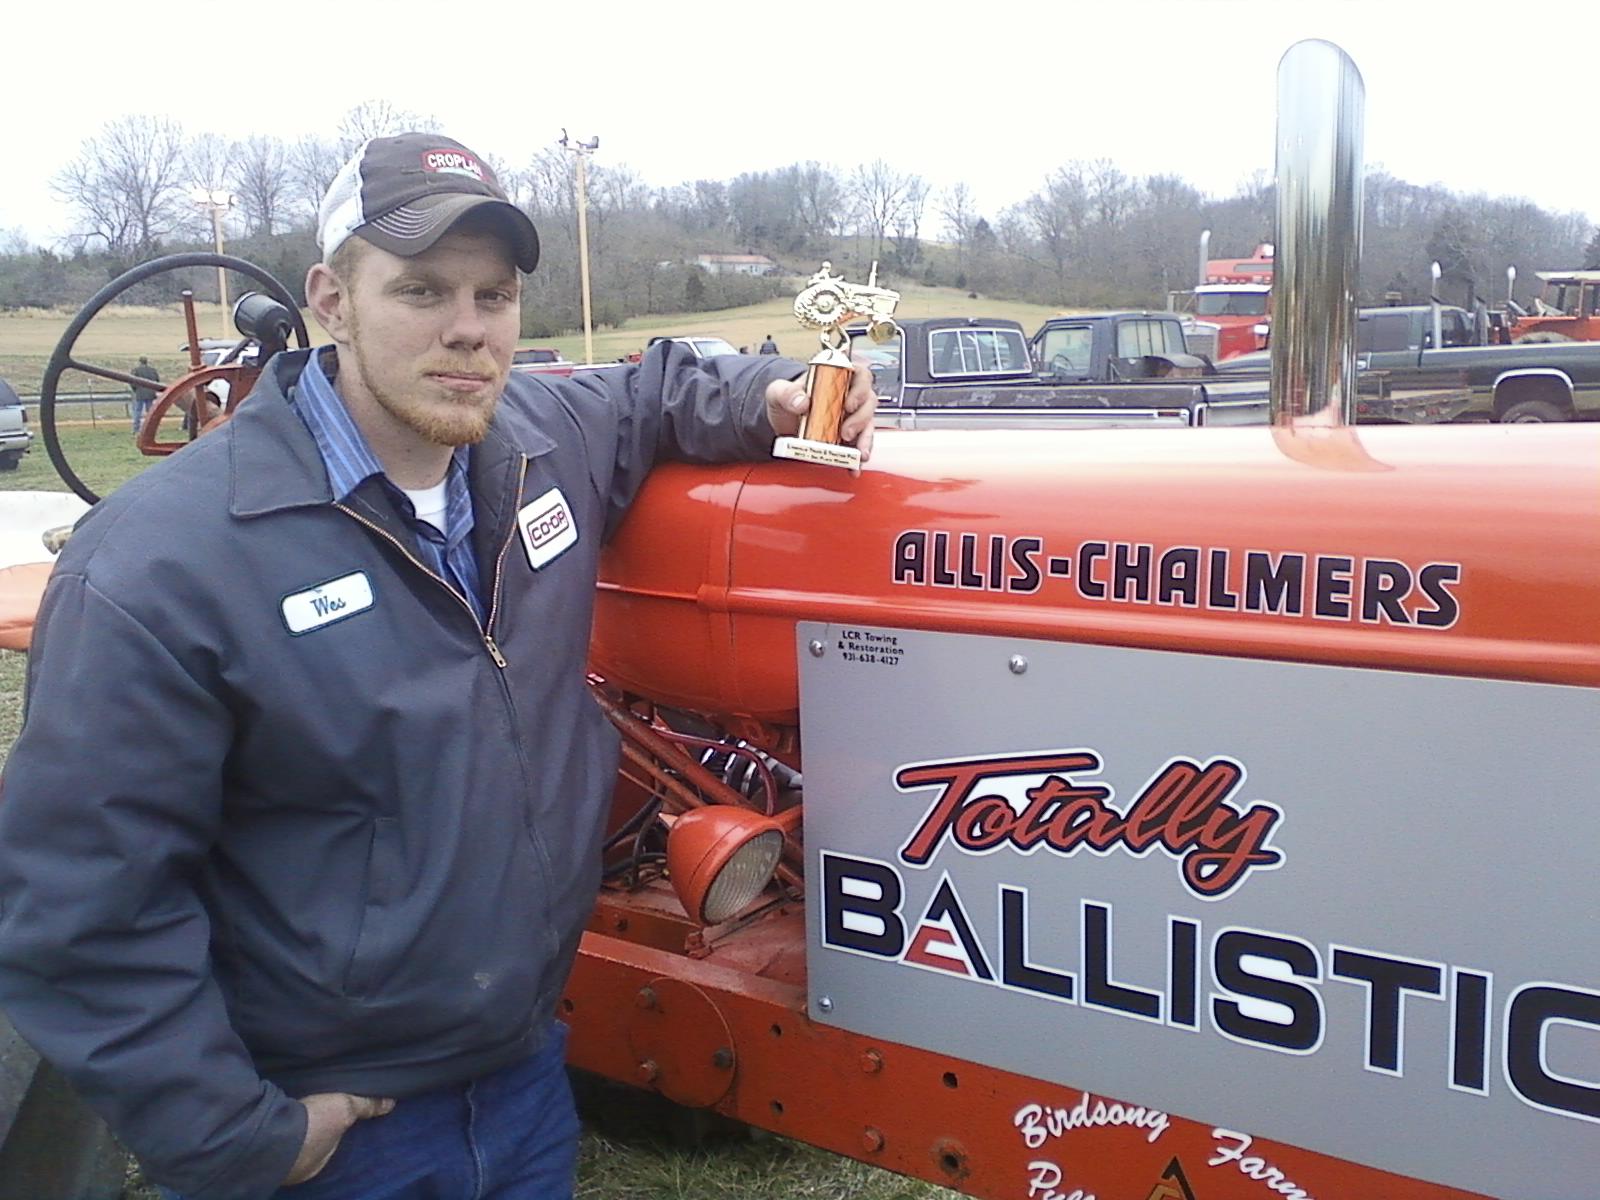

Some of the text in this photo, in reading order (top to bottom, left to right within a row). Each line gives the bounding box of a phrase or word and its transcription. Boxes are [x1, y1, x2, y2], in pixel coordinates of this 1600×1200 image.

[531, 511, 565, 541] CO-OP
[893, 529, 1461, 630] ALLIS-CHALMERS
[310, 595, 346, 617] Wes
[838, 641, 904, 655] & Restoration
[842, 630, 898, 645] LCR Towing
[843, 652, 899, 665] 931-638-4127
[894, 749, 1286, 900] Totally
[1014, 1091, 1170, 1149] Birdsong
